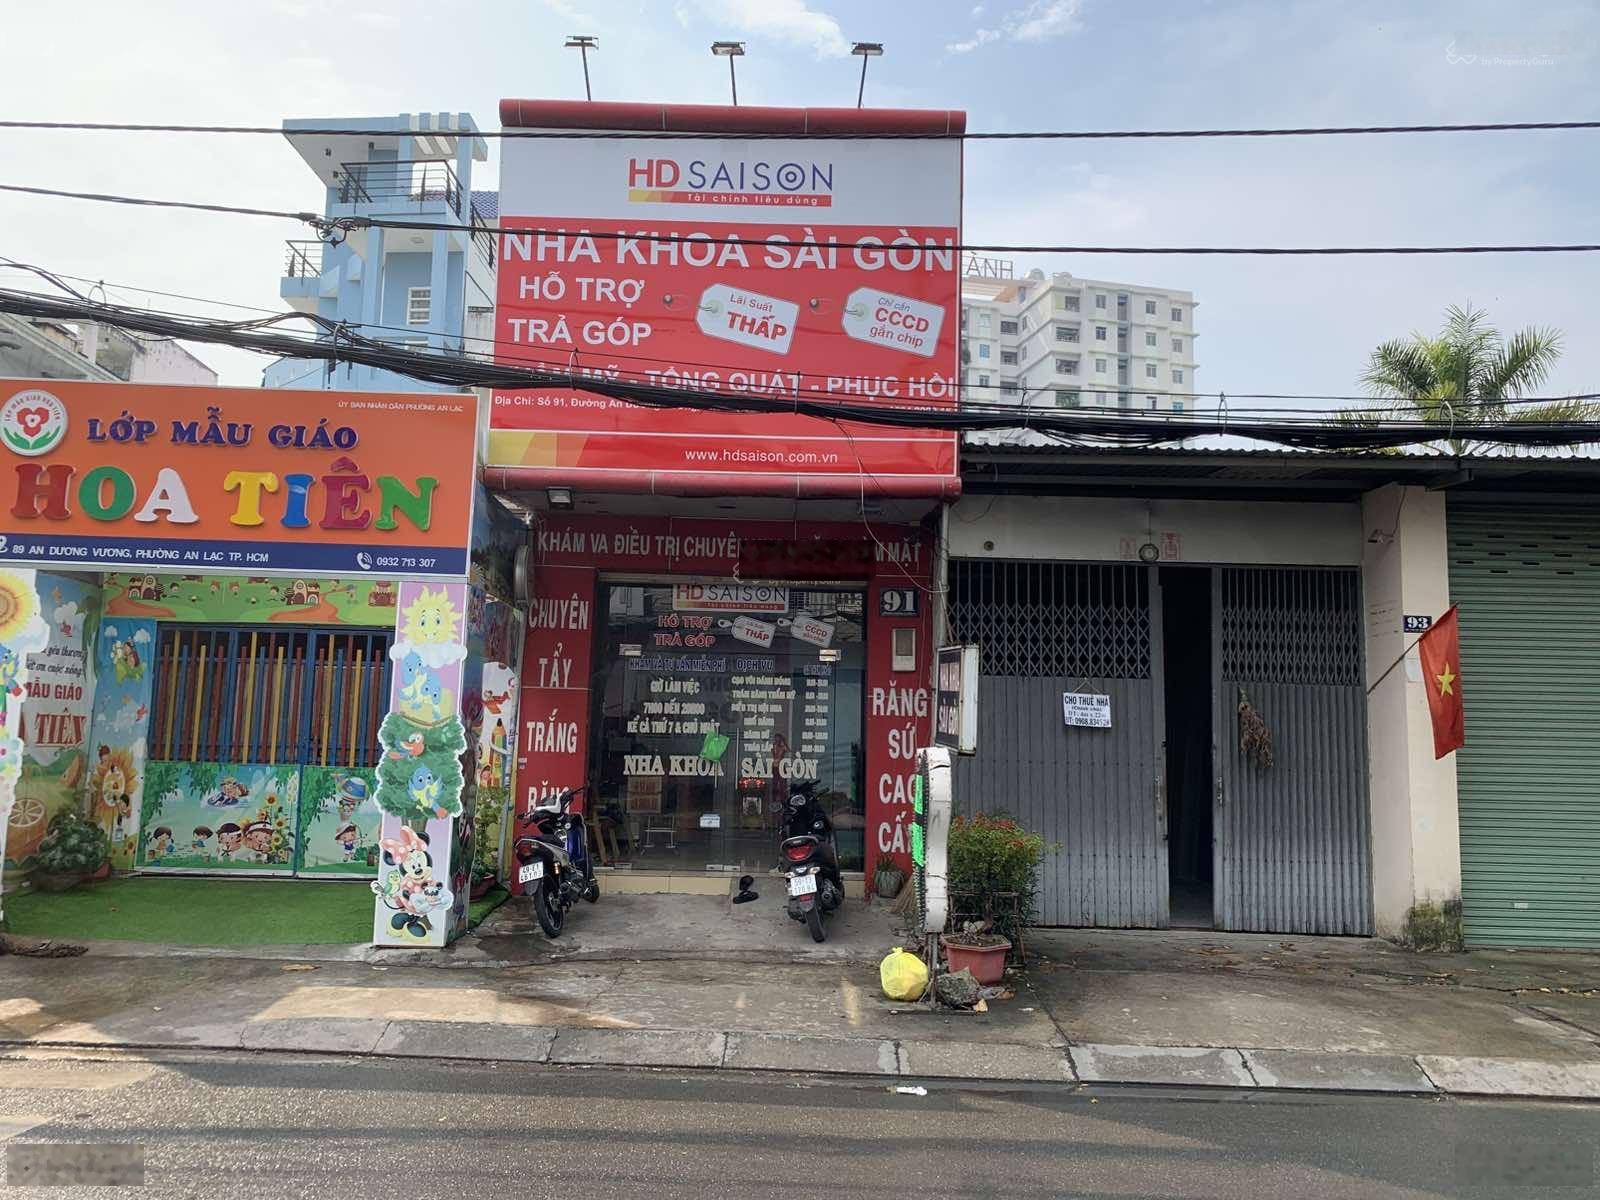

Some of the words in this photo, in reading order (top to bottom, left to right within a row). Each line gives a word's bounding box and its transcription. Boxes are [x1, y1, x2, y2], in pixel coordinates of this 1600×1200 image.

[628, 158, 680, 188] HD
[687, 160, 833, 192] SAISON
[503, 227, 601, 263] NHA
[616, 230, 749, 268] KHOA
[763, 227, 837, 270] SÀI
[853, 228, 953, 272] GÒN
[519, 271, 566, 300] HỖ
[575, 277, 645, 309] TRỢ
[729, 292, 747, 305] Lãi
[748, 299, 774, 313] Suất
[507, 314, 573, 344] TRẢ
[582, 316, 652, 346] GÓP
[727, 311, 787, 340] THẤP
[875, 307, 930, 332] CCCD
[896, 330, 924, 348] chip
[728, 369, 803, 395] QUÁT
[827, 376, 900, 400] PHỤC
[494, 396, 511, 407] Địa
[570, 398, 606, 409] Đường
[609, 399, 623, 408] An
[86, 410, 158, 444] LỚP
[170, 407, 252, 447] MẪU
[268, 418, 358, 449] GIÁO
[685, 449, 838, 463] www.hdsaison.com.vn
[10, 463, 200, 523] HOA
[223, 457, 440, 531] TIÊN
[12, 545, 24, 554] 89
[29, 546, 44, 555] AN
[50, 546, 88, 557] DƯƠNG
[136, 547, 180, 560] PHƯỜNG
[184, 551, 199, 560] AN
[203, 552, 224, 562] LẠC
[229, 552, 242, 561] TP.
[246, 553, 269, 562] HCM
[537, 526, 585, 553] KHÁM
[614, 525, 650, 555] ĐIỀU
[655, 535, 680, 562] TRỊ
[684, 531, 740, 558] CHUYÊ
[376, 557, 399, 566] 0932
[401, 557, 416, 567] 713
[418, 558, 436, 568] 307
[707, 585, 787, 602] SAISON
[883, 590, 917, 612] 91
[527, 593, 589, 631] CHUYÊN
[1407, 616, 1429, 629] 93
[538, 642, 572, 688] TẨY
[54, 680, 82, 701] GIÁO
[872, 679, 928, 717] RĂNG
[1064, 696, 1077, 705] CHO
[526, 708, 578, 753] TRẮNG
[888, 721, 916, 760] SỨ
[623, 754, 665, 775] NHA
[668, 755, 724, 776] KHOA
[741, 752, 774, 778] SÀI
[778, 751, 818, 779] GÒN
